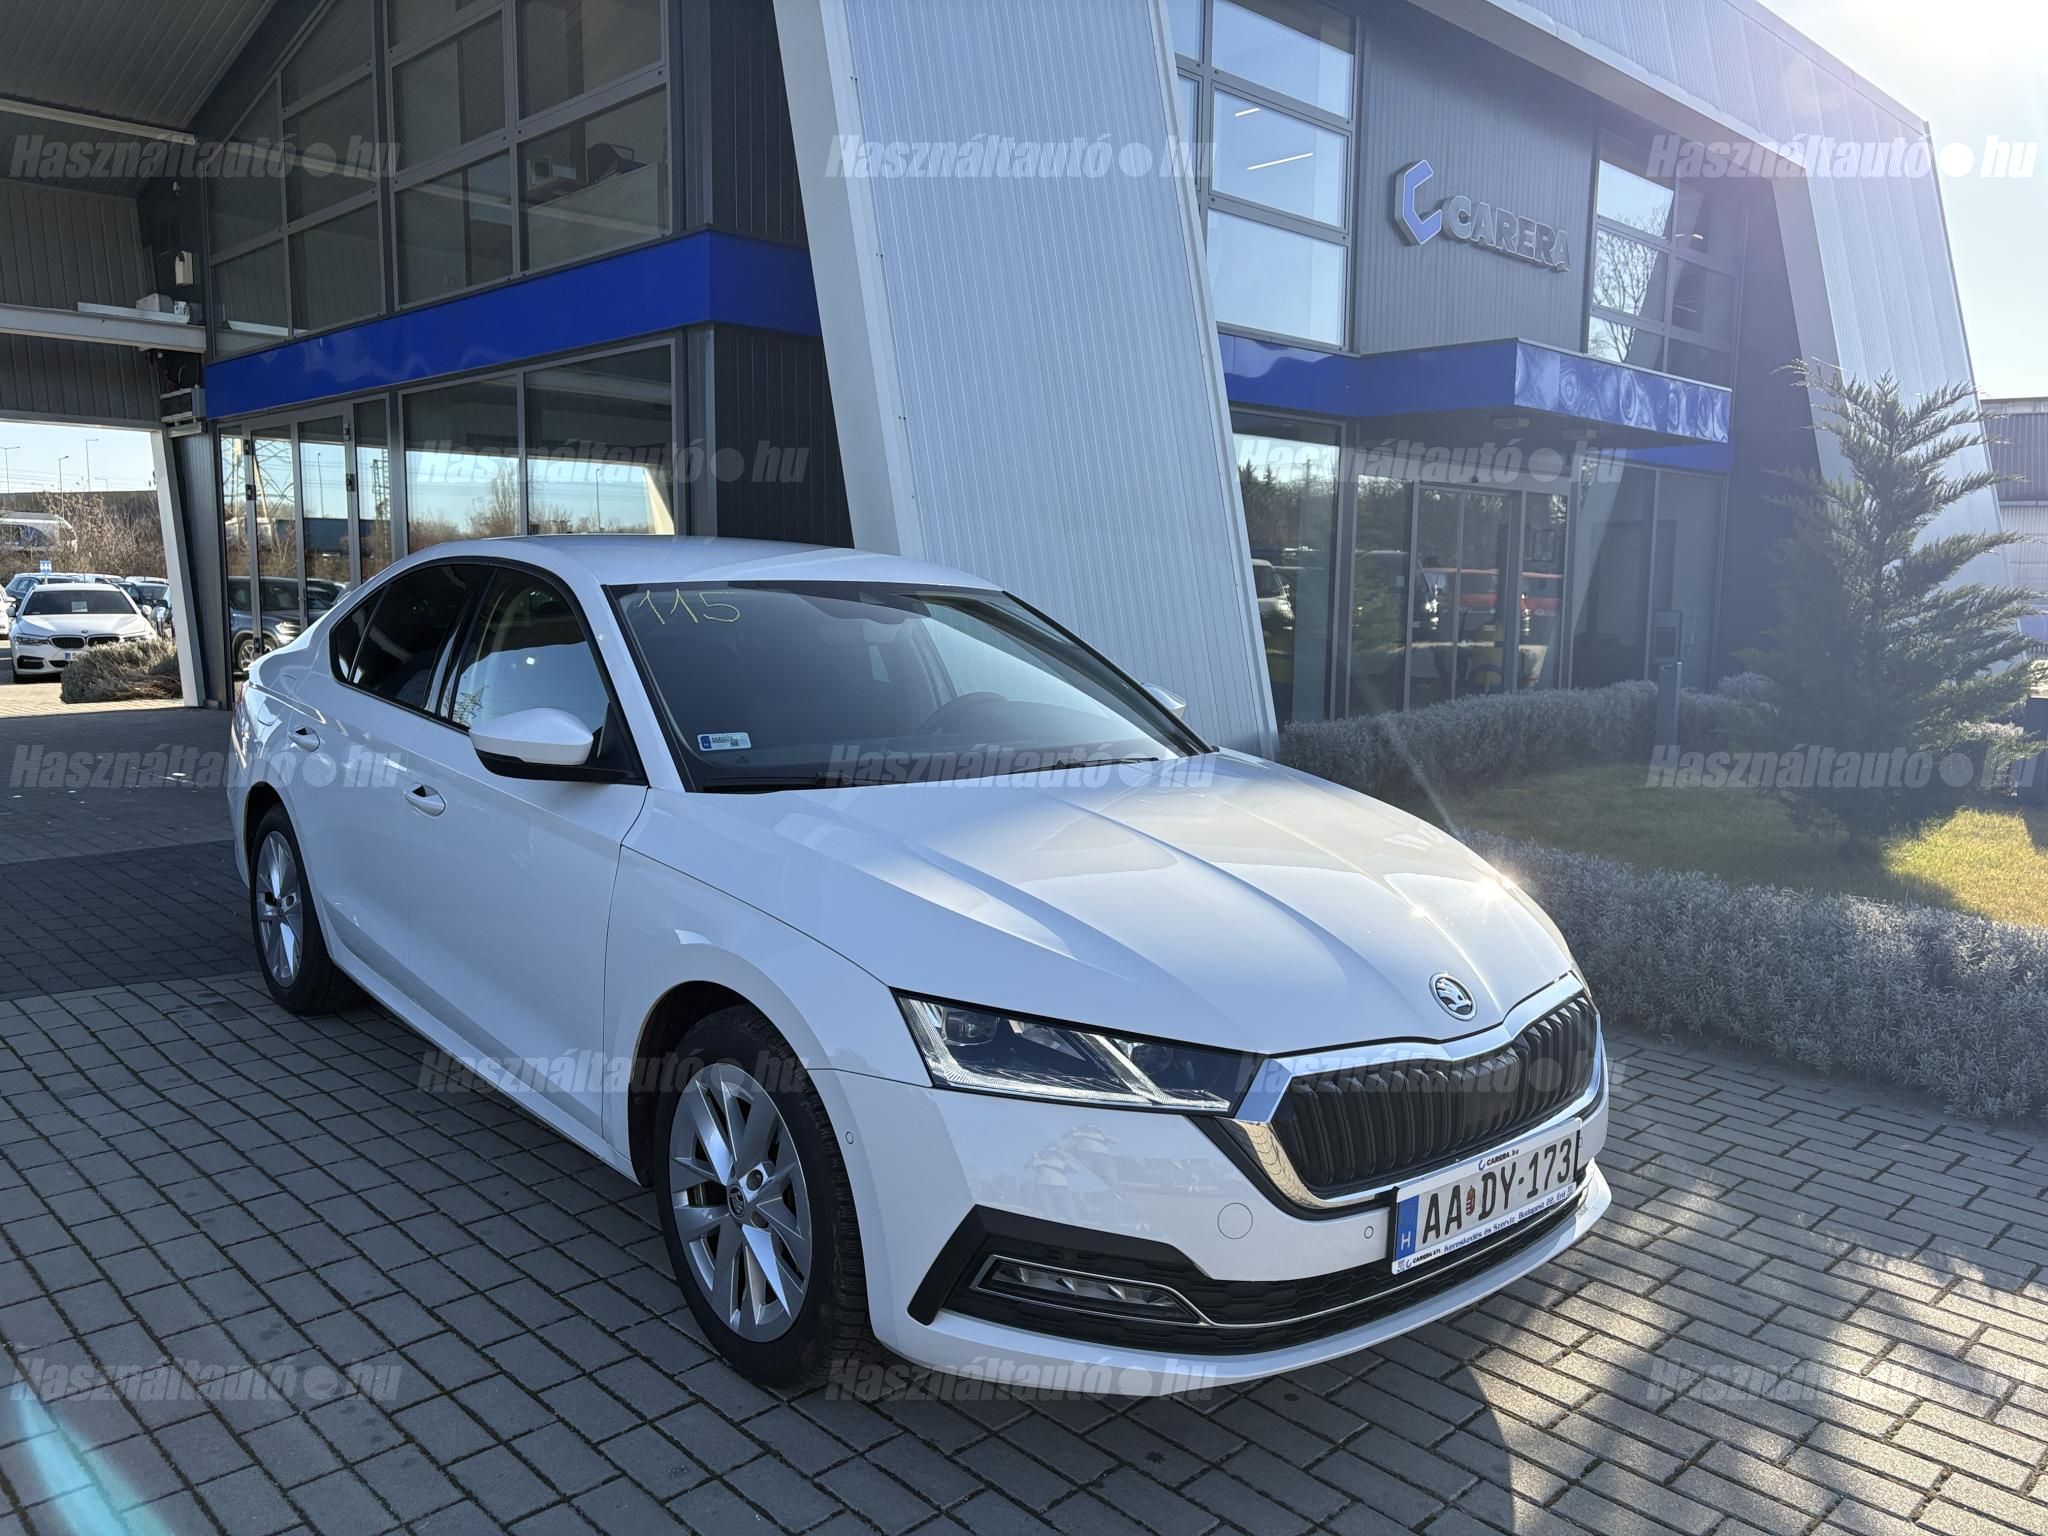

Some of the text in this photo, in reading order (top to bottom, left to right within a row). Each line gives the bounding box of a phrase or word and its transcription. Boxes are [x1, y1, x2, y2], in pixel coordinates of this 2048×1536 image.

[1443, 195, 1571, 272] CARERA
[638, 588, 741, 625] 115
[1401, 1230, 1411, 1251] H
[1422, 1184, 1463, 1244] AA
